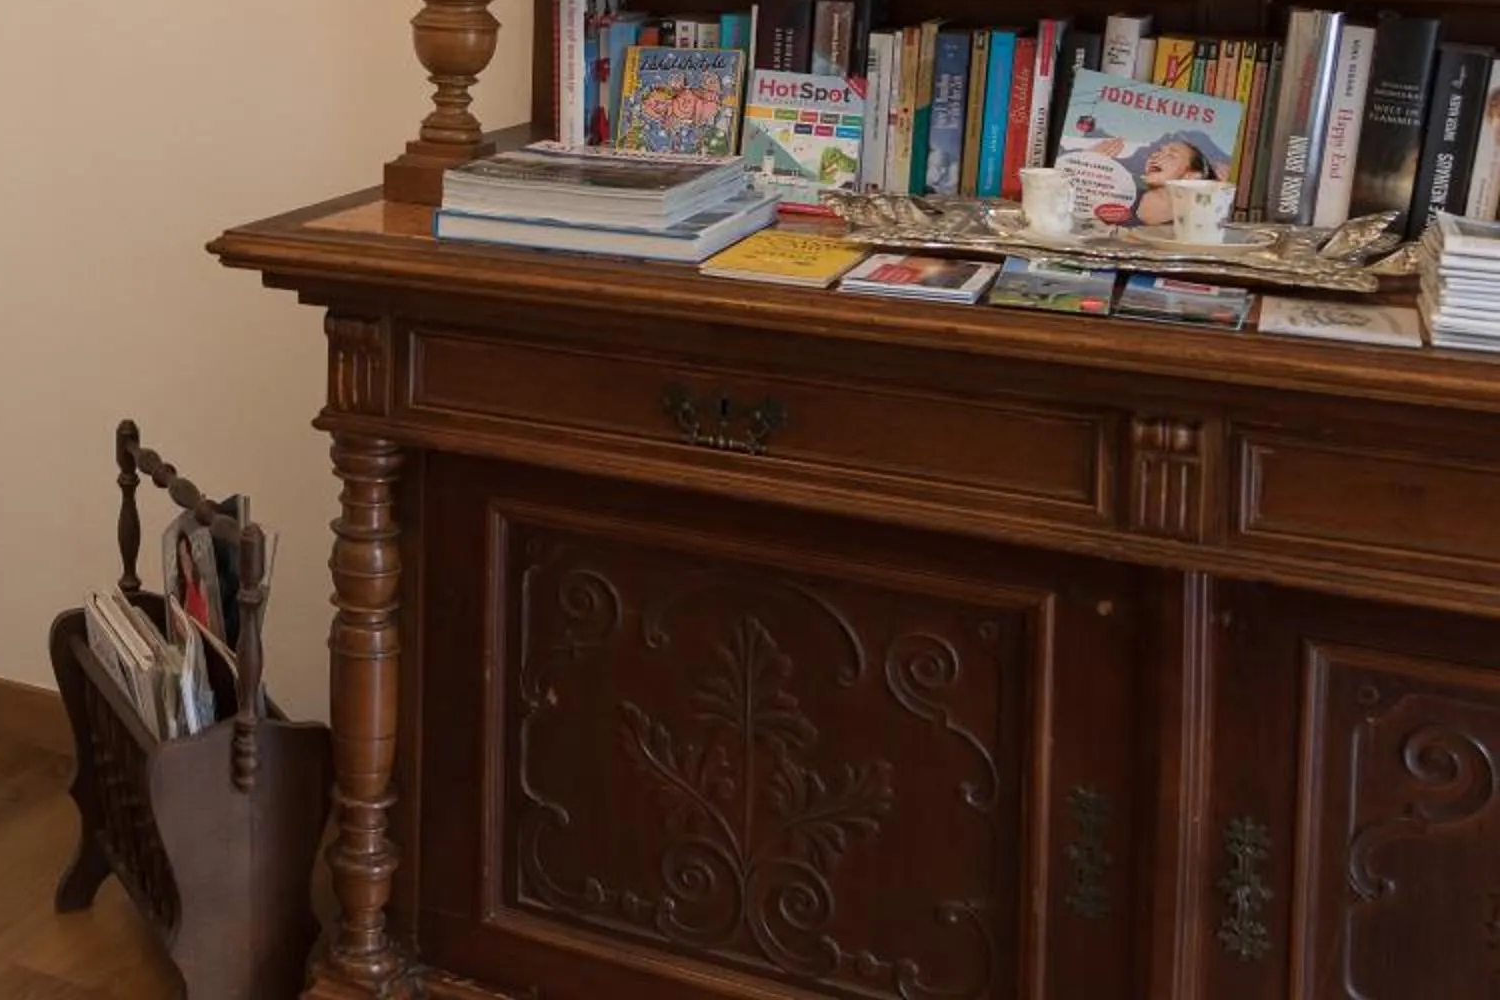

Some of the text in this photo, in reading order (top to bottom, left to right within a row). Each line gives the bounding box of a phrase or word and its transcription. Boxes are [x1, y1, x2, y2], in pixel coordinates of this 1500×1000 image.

[759, 77, 852, 104] HotSpot
[1330, 109, 1354, 148] Happy
[1330, 153, 1347, 179] End
